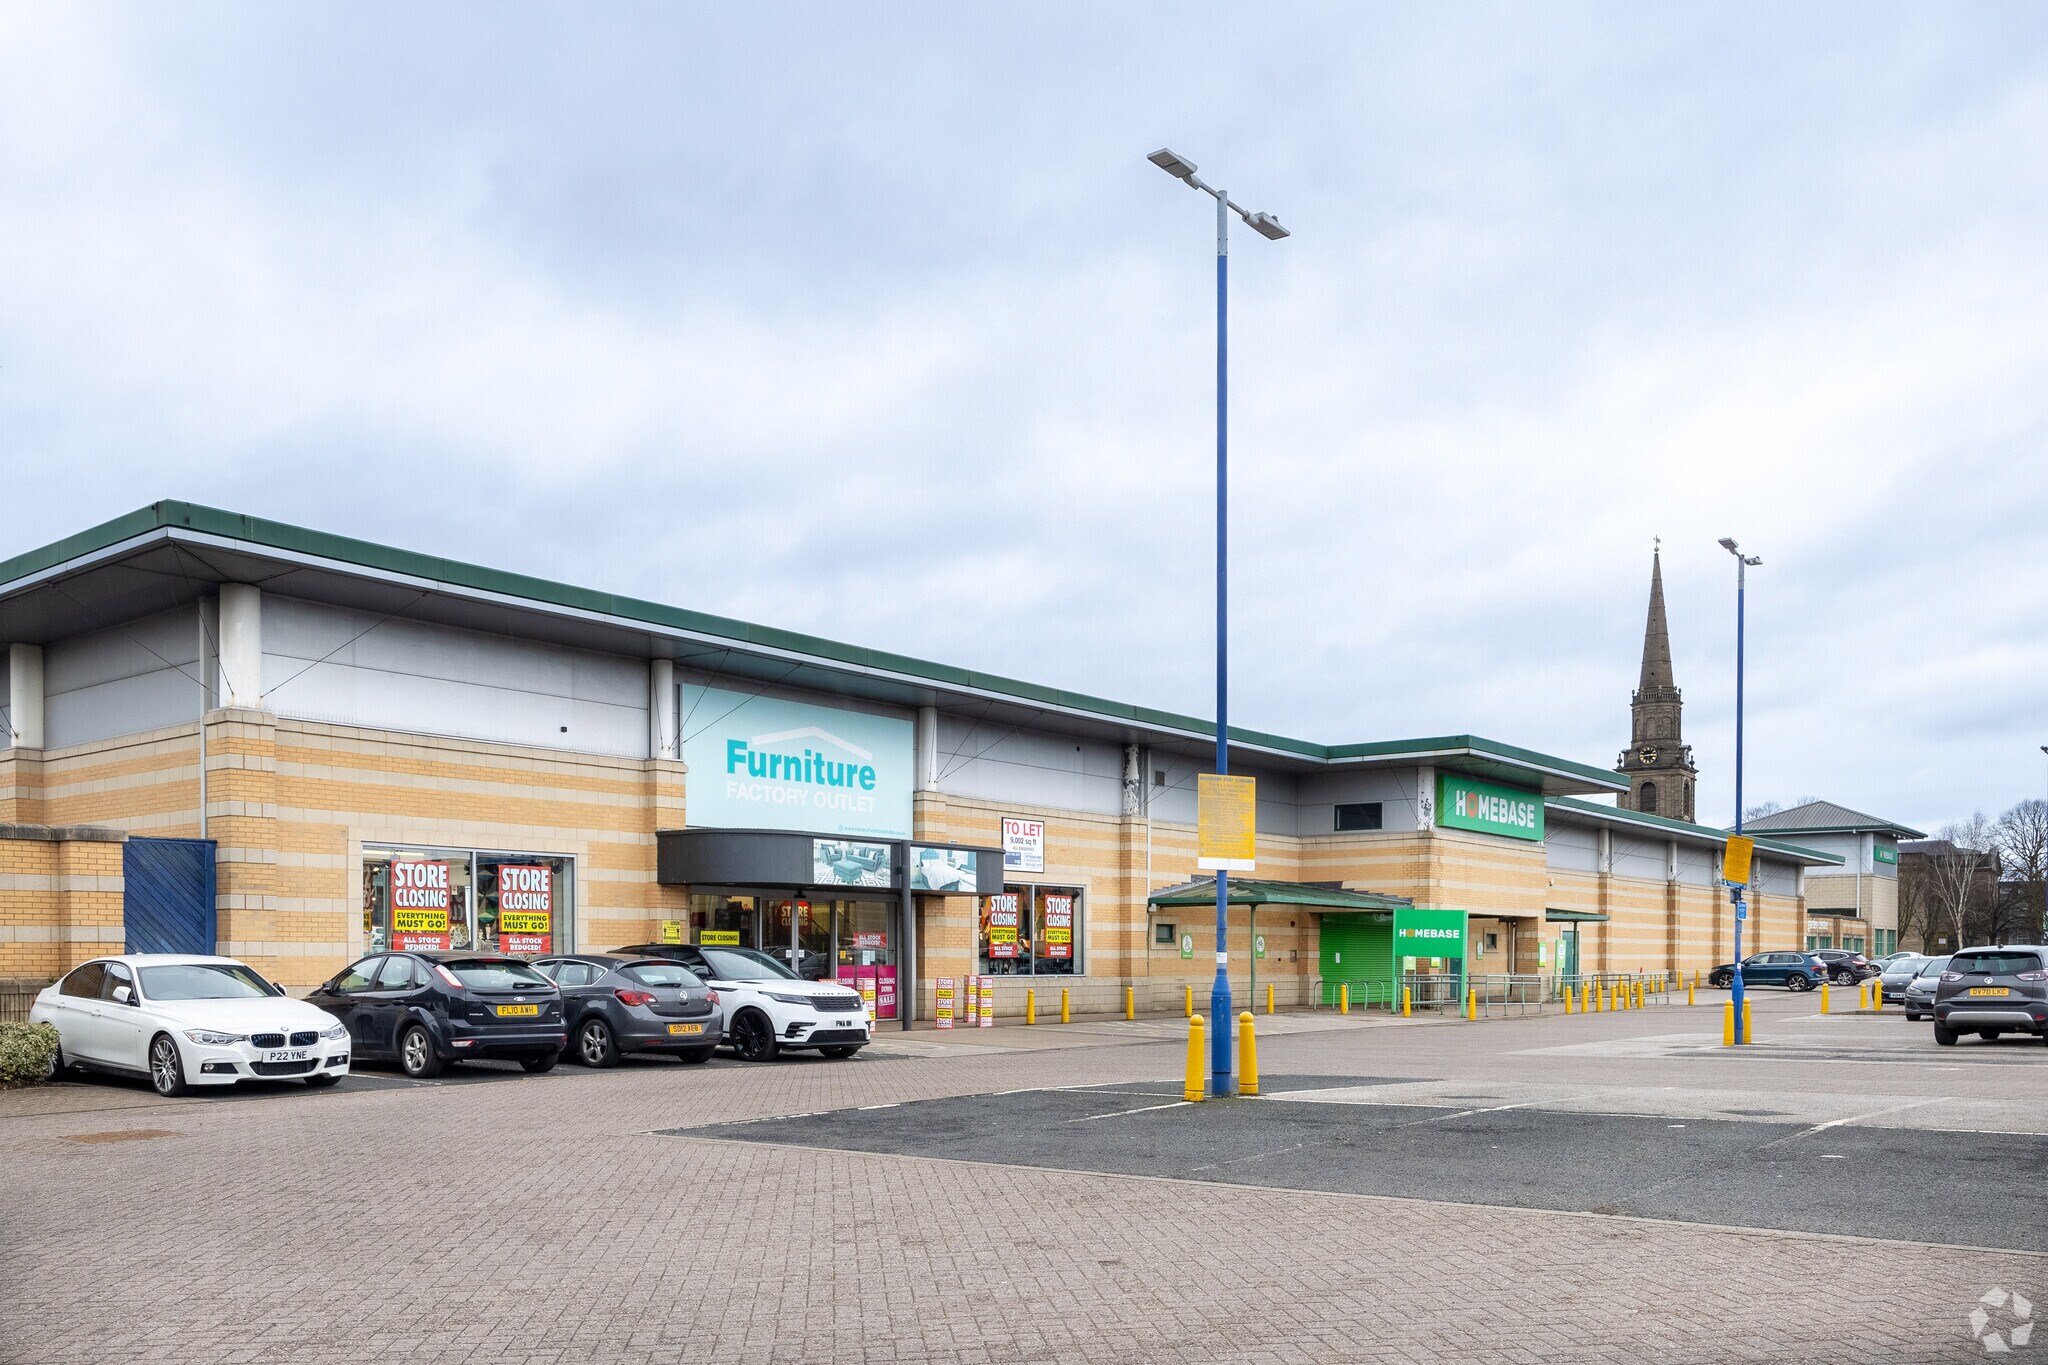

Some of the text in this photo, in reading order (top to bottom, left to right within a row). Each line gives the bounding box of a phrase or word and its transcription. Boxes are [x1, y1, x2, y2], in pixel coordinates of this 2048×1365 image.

[727, 739, 876, 791] Furniture
[726, 781, 876, 812] FACTORY OUTLET
[1455, 789, 1535, 829] HOMEBASE
[1005, 821, 1042, 837] TO LET
[1010, 836, 1024, 846] 9,002
[1025, 838, 1032, 846] sq
[395, 862, 448, 888] STORE
[502, 867, 549, 892] STORE
[395, 888, 448, 908] CLOSING
[502, 892, 549, 910] CLOSING
[991, 895, 1017, 912] STORE
[781, 905, 808, 917] STRE
[1046, 897, 1071, 914] STORE
[397, 920, 446, 928] MUST GO!
[503, 921, 548, 930] MUST GO!
[991, 913, 1017, 926] CLOSING
[1046, 914, 1071, 928] CLOSING
[701, 934, 739, 943] STORE CLOSING!
[1399, 928, 1460, 939] HOMEBASE
[1972, 988, 1990, 996] DV70
[879, 995, 895, 1004] SALE
[501, 1006, 534, 1015] FL10 AWH
[270, 1050, 307, 1061] P22 YNE
